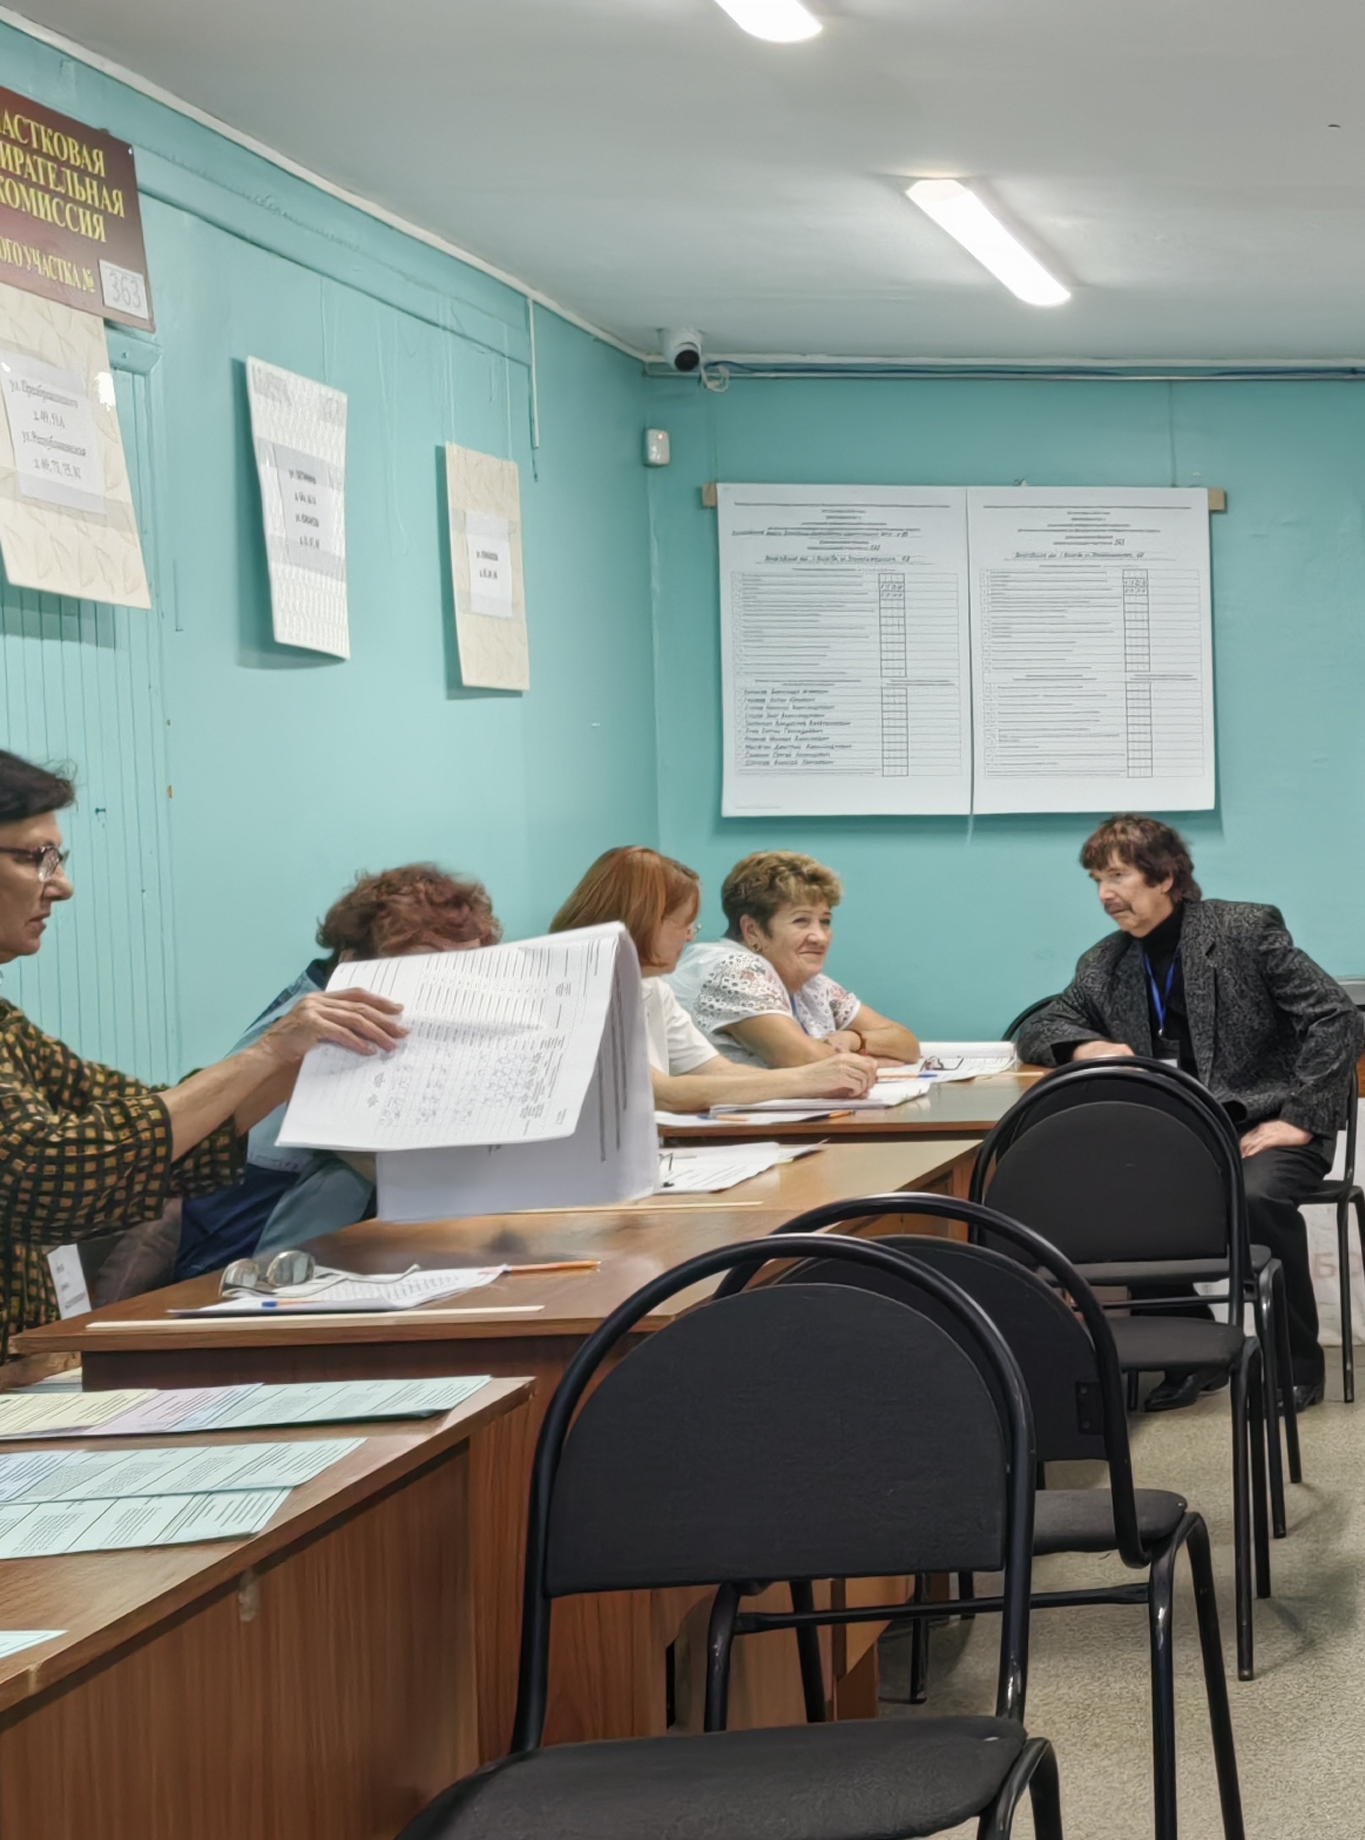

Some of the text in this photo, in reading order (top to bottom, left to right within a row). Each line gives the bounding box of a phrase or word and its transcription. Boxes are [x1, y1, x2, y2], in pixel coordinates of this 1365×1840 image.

[0, 109, 106, 177] АСТКОВАЯ
[21, 244, 81, 289] УЧАСТКА
[109, 270, 141, 309] 363
